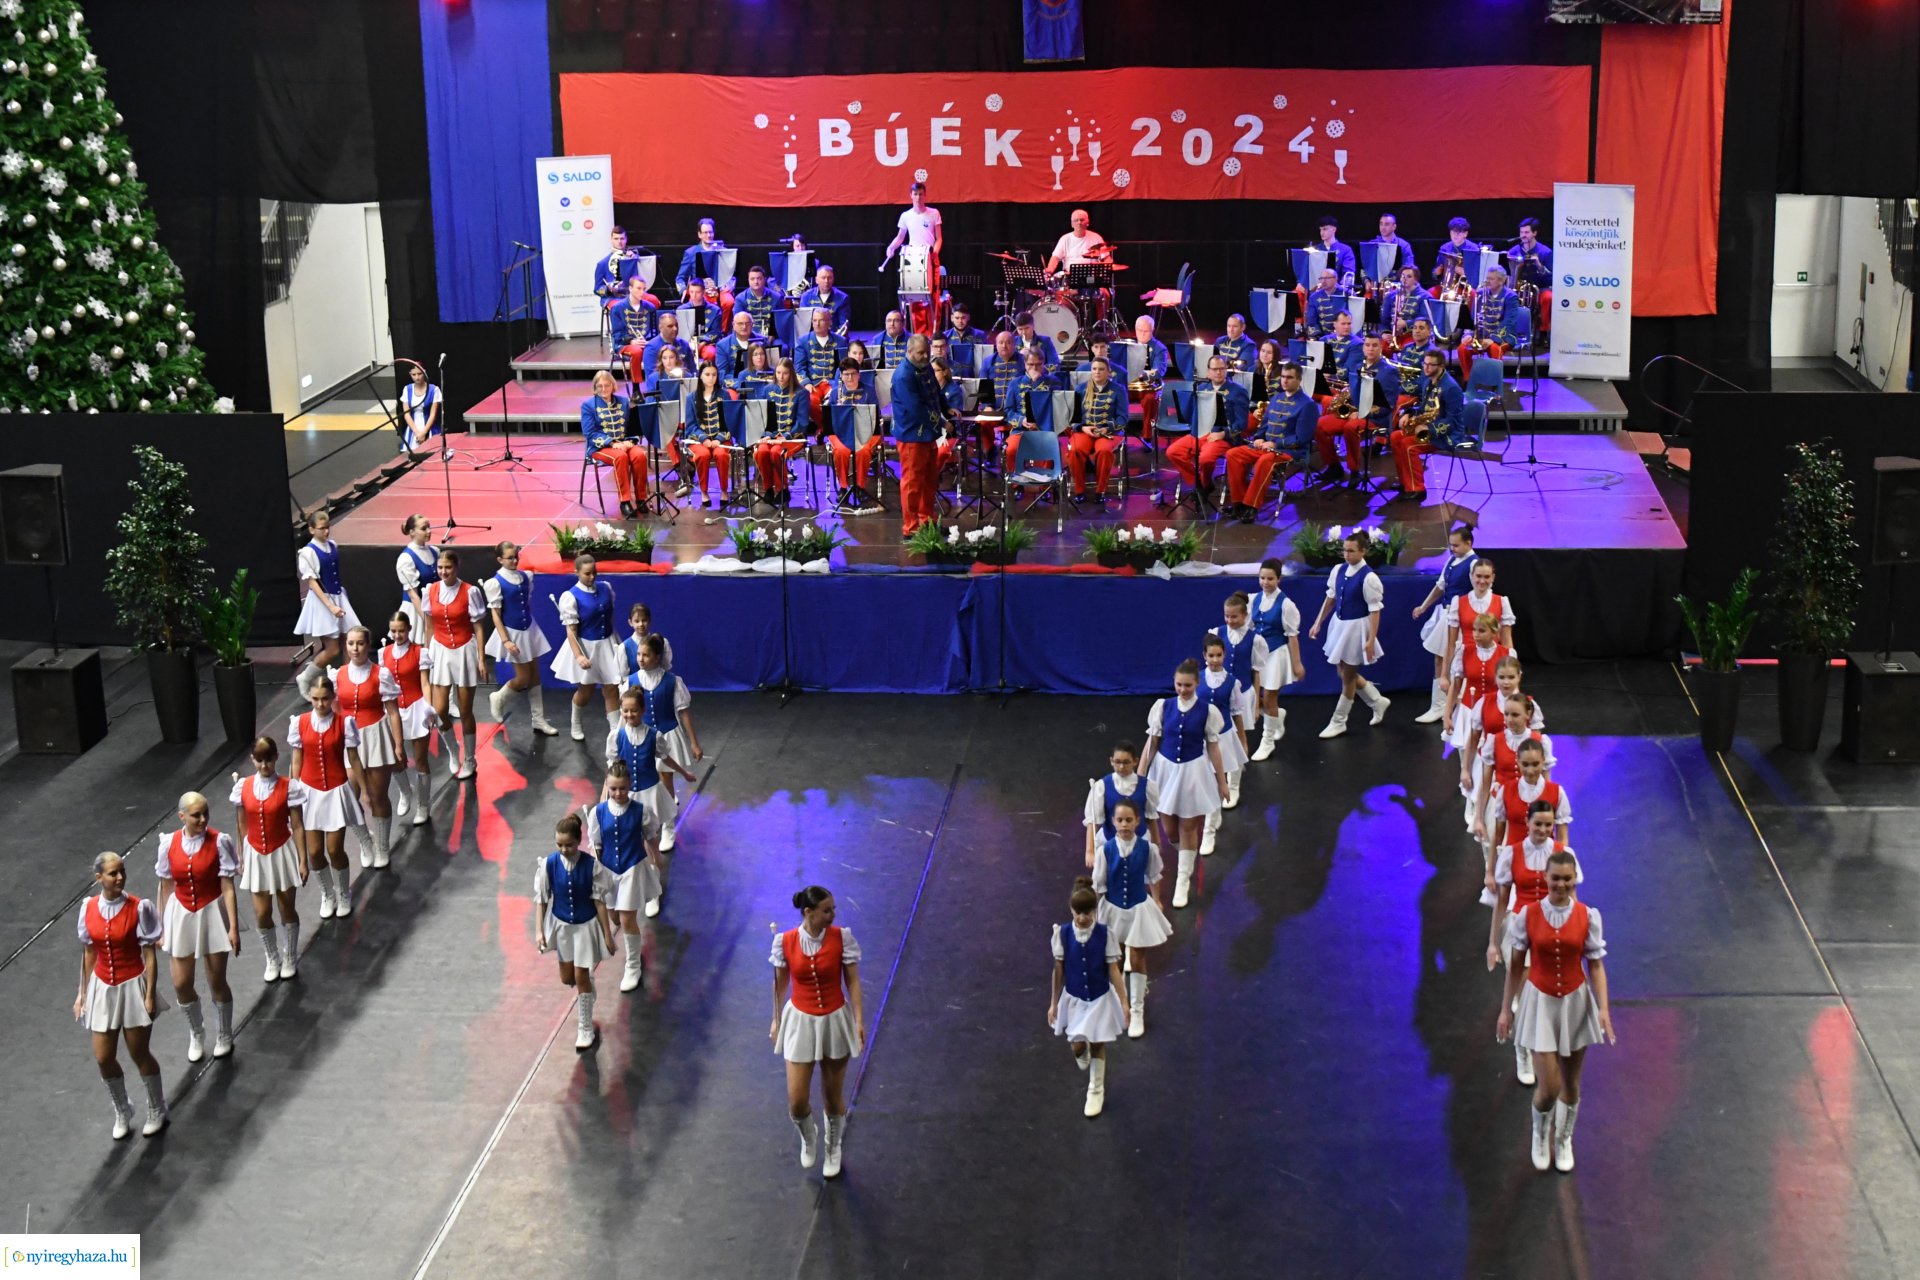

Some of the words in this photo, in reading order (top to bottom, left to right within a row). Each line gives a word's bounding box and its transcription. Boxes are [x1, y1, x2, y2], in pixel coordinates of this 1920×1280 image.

[818, 102, 1023, 168] BÚÉK
[1130, 114, 1315, 164] 2024
[563, 171, 602, 182] SALDO
[1565, 216, 1620, 227] Szeretettel
[1565, 227, 1619, 240] köszöntjük
[1559, 239, 1626, 250] vendégeinket!
[1579, 276, 1620, 288] SALDO
